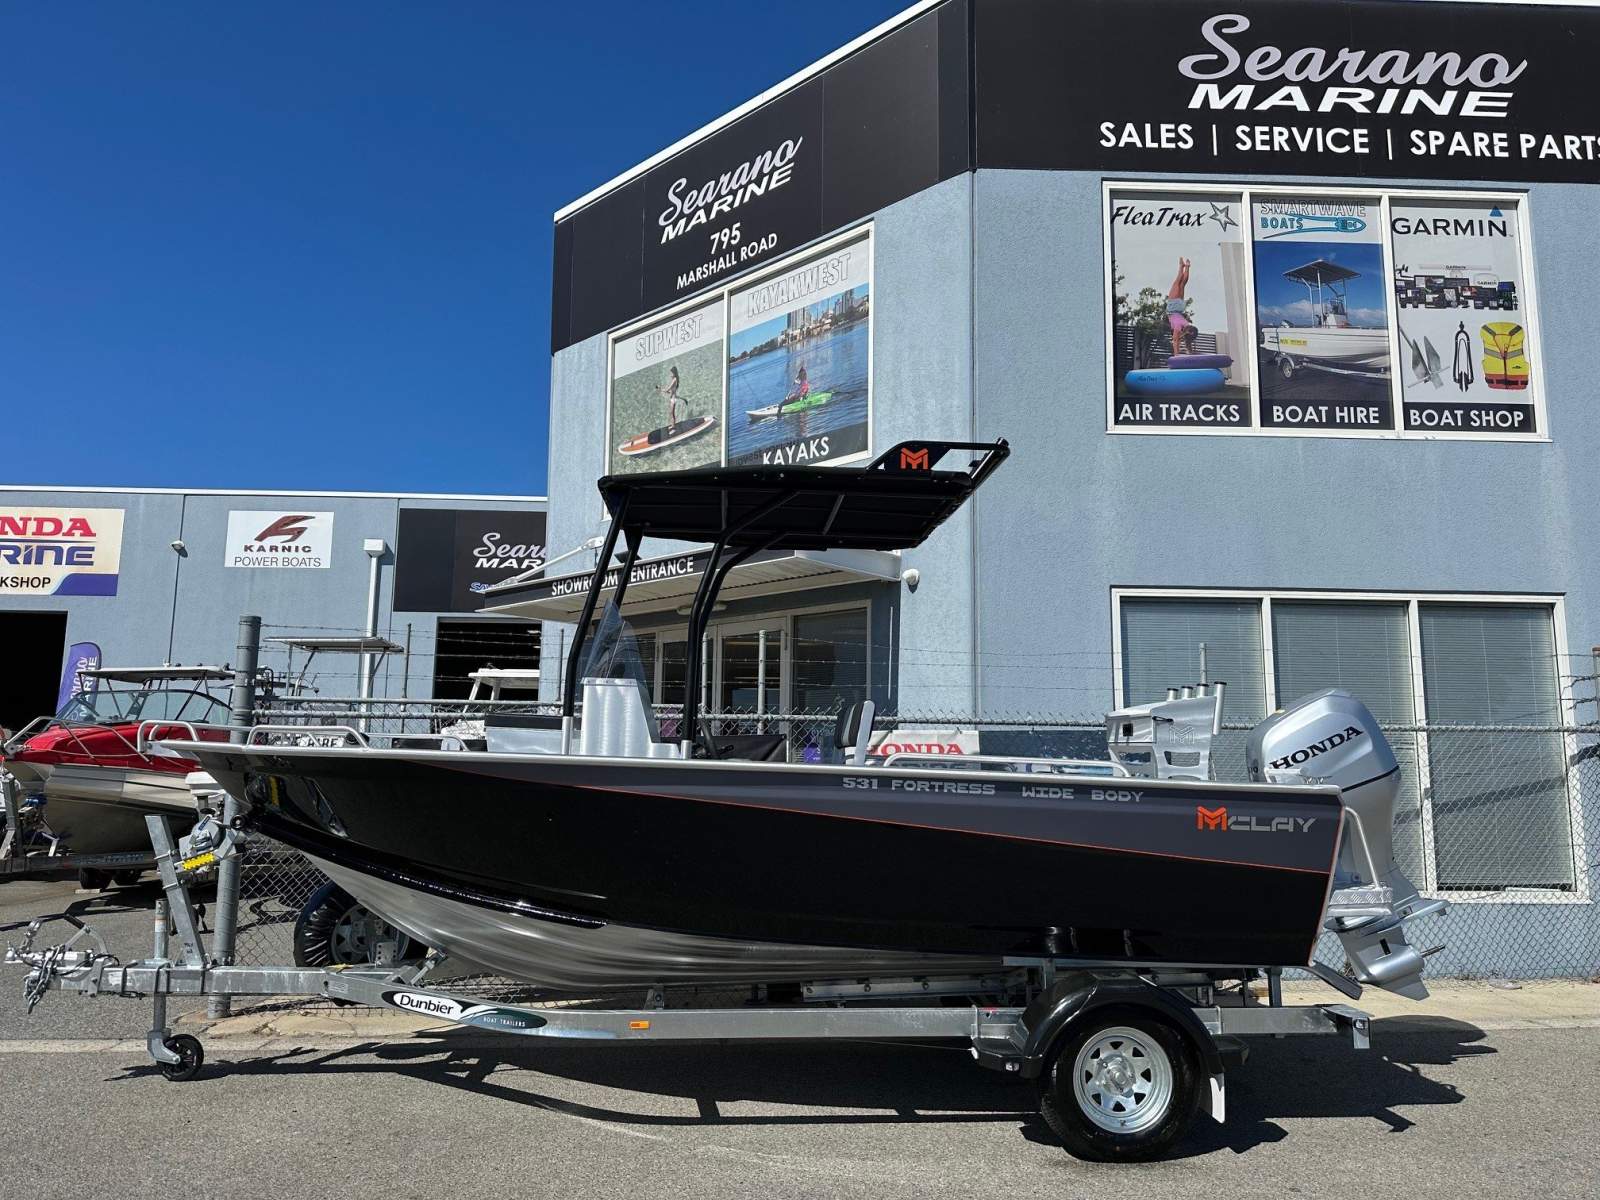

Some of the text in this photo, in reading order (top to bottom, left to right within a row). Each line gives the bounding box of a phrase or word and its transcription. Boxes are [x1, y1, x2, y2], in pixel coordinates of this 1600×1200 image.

[1178, 13, 1527, 88] Searano
[1187, 83, 1514, 118] MARINE
[1099, 121, 1194, 150] SALES
[1235, 125, 1370, 154] SERVICE
[1409, 129, 1510, 158] SPARE
[658, 136, 803, 226] Searano
[660, 162, 795, 245] MARINE
[1110, 206, 1207, 227] FleaTrax
[1260, 199, 1367, 217] SMARTWAVE
[1260, 216, 1304, 230] BOATS
[1390, 217, 1508, 238] GARMIN
[710, 222, 742, 255] 795
[676, 233, 778, 290] MARSHALL ROAD
[748, 252, 851, 319] KAYAKWEST
[636, 314, 703, 361] SUPWEST
[1118, 403, 1240, 422] AIR TRACKS
[1272, 405, 1380, 424] BOAT HIRE
[1409, 409, 1524, 428] BOAT SHOP
[762, 436, 830, 465] KAYAKS
[234, 556, 322, 567] POWER BOATS
[243, 544, 312, 553] KARNIC
[630, 556, 694, 583] ENTRANCE
[1269, 726, 1363, 770] HONDA
[842, 777, 1144, 802] 531 FORTRESS WIDE BODY
[400, 994, 454, 1015] Dunbier
